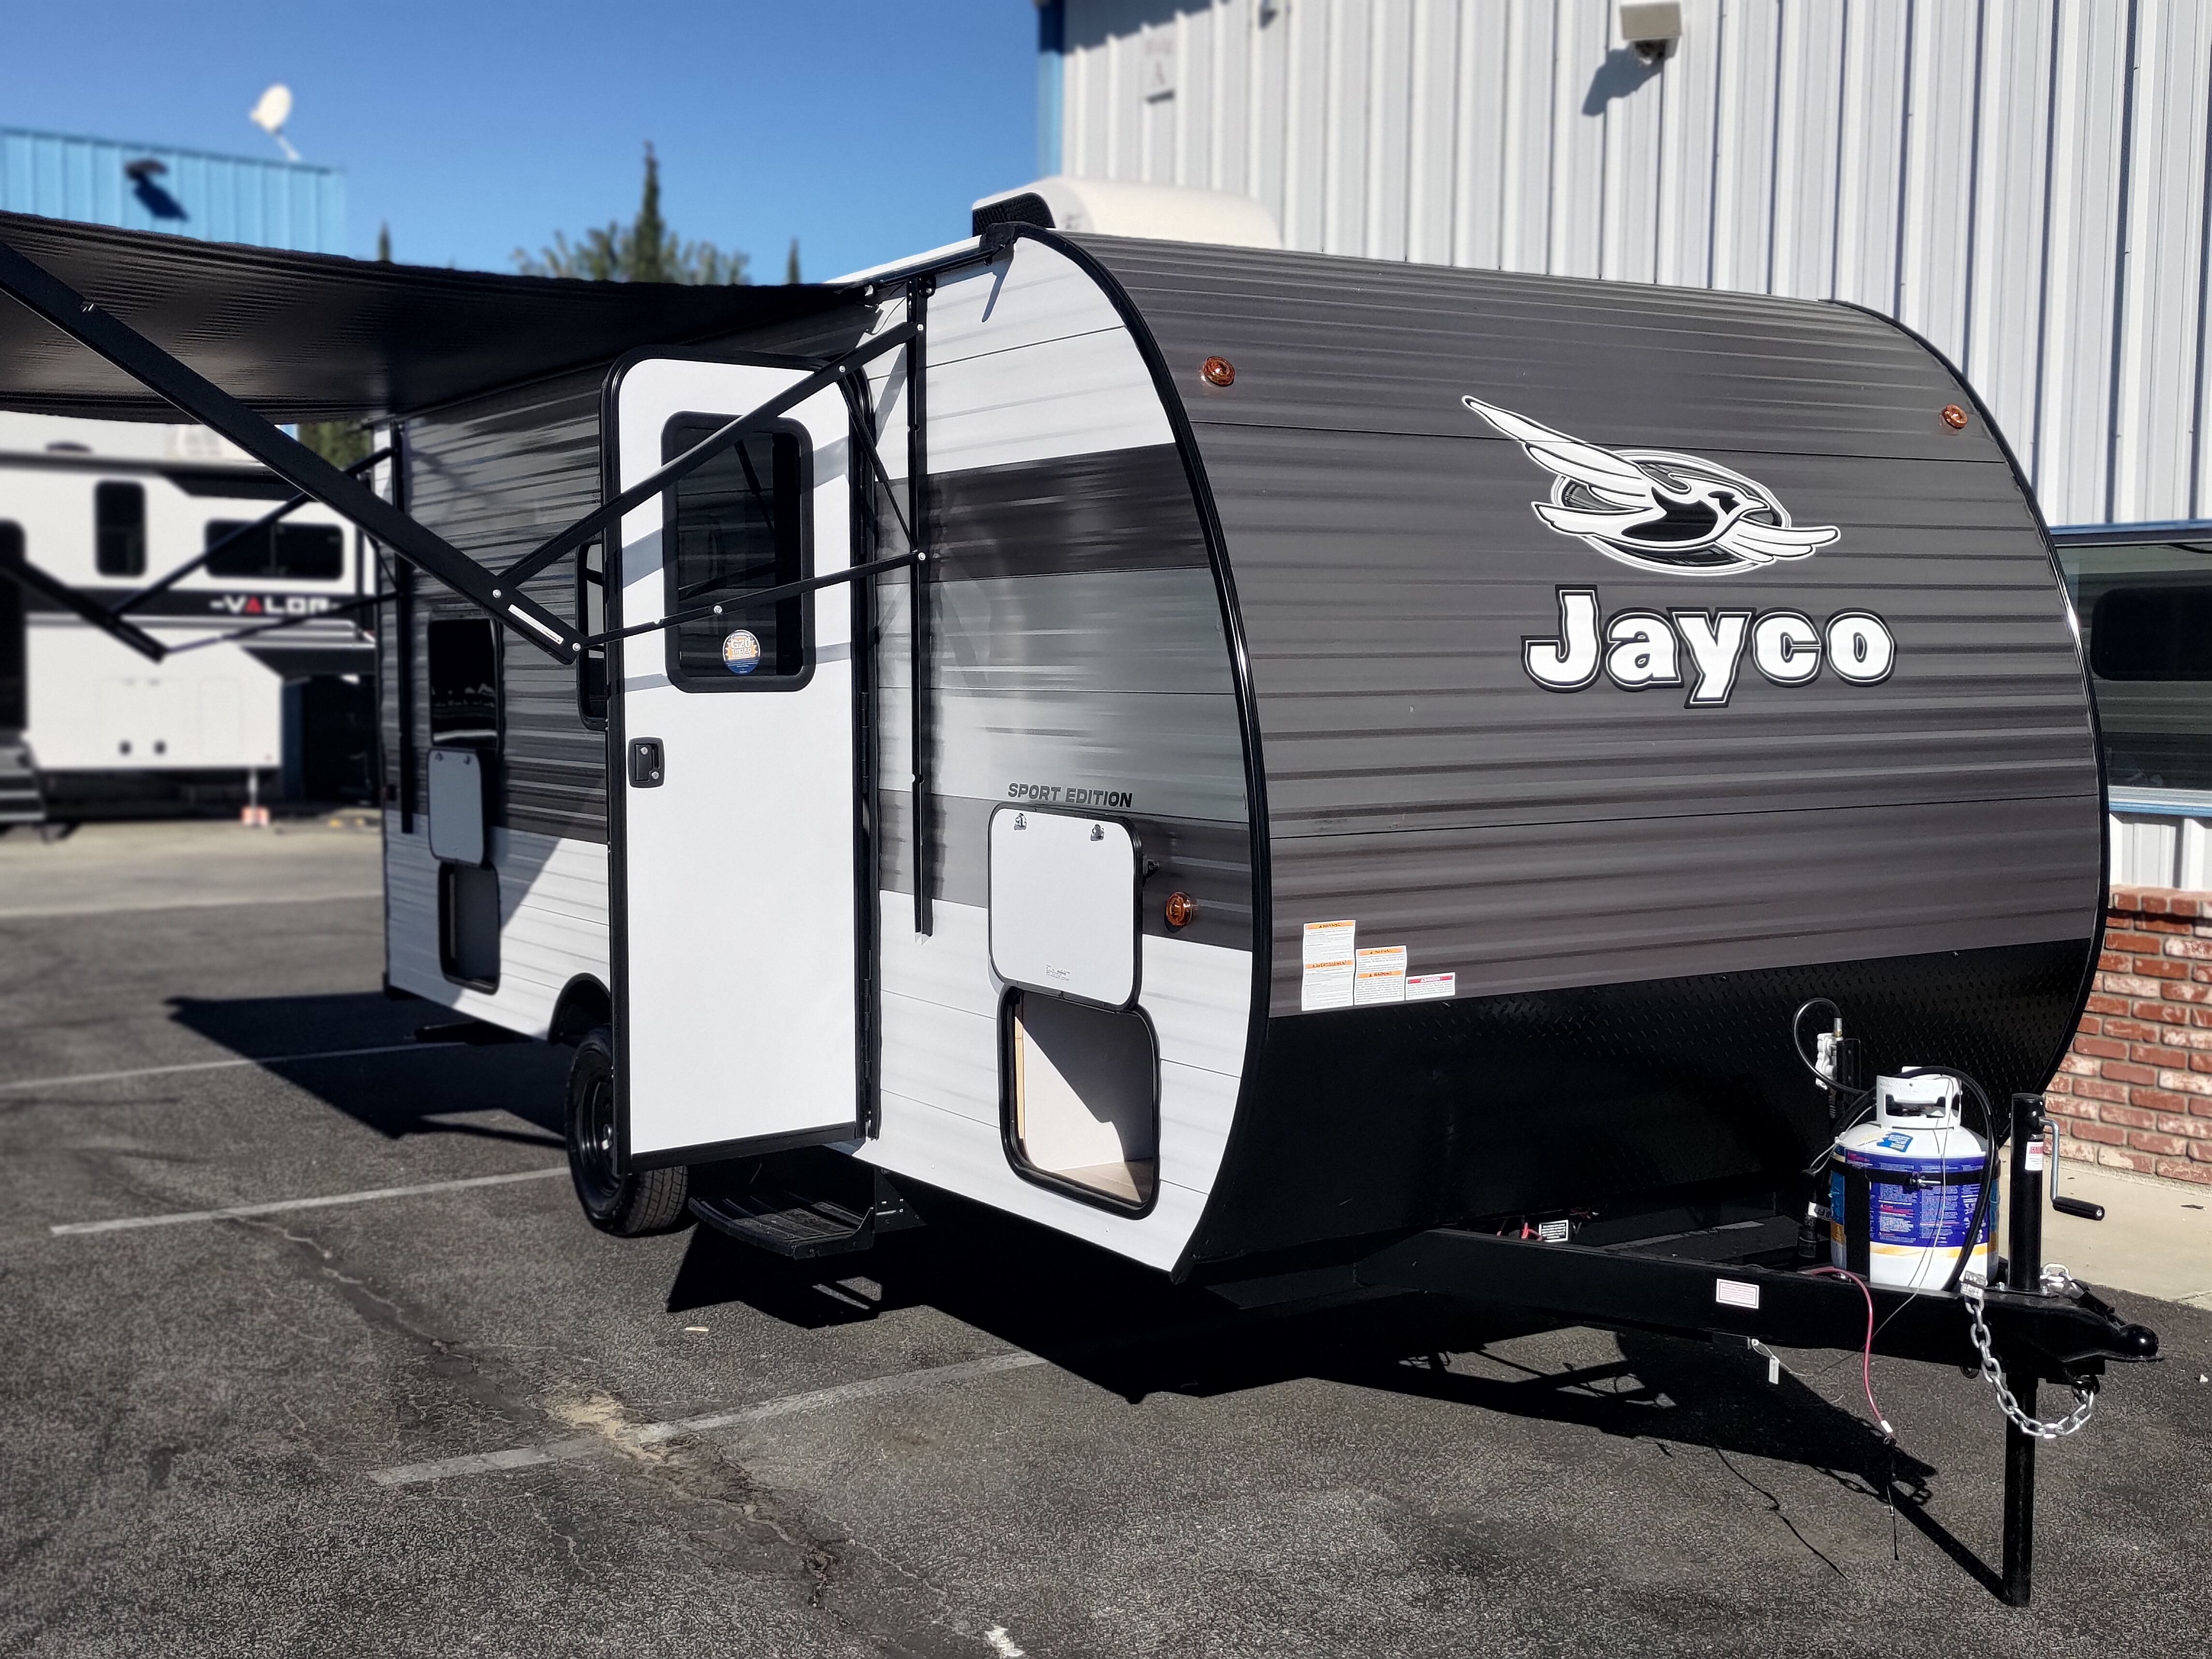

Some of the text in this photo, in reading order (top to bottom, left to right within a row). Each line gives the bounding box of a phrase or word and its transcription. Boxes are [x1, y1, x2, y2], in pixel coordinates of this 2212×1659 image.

[730, 639, 751, 649] G20
[1521, 584, 1898, 709] Jayco
[1008, 783, 1133, 808] SPORT EDITION
